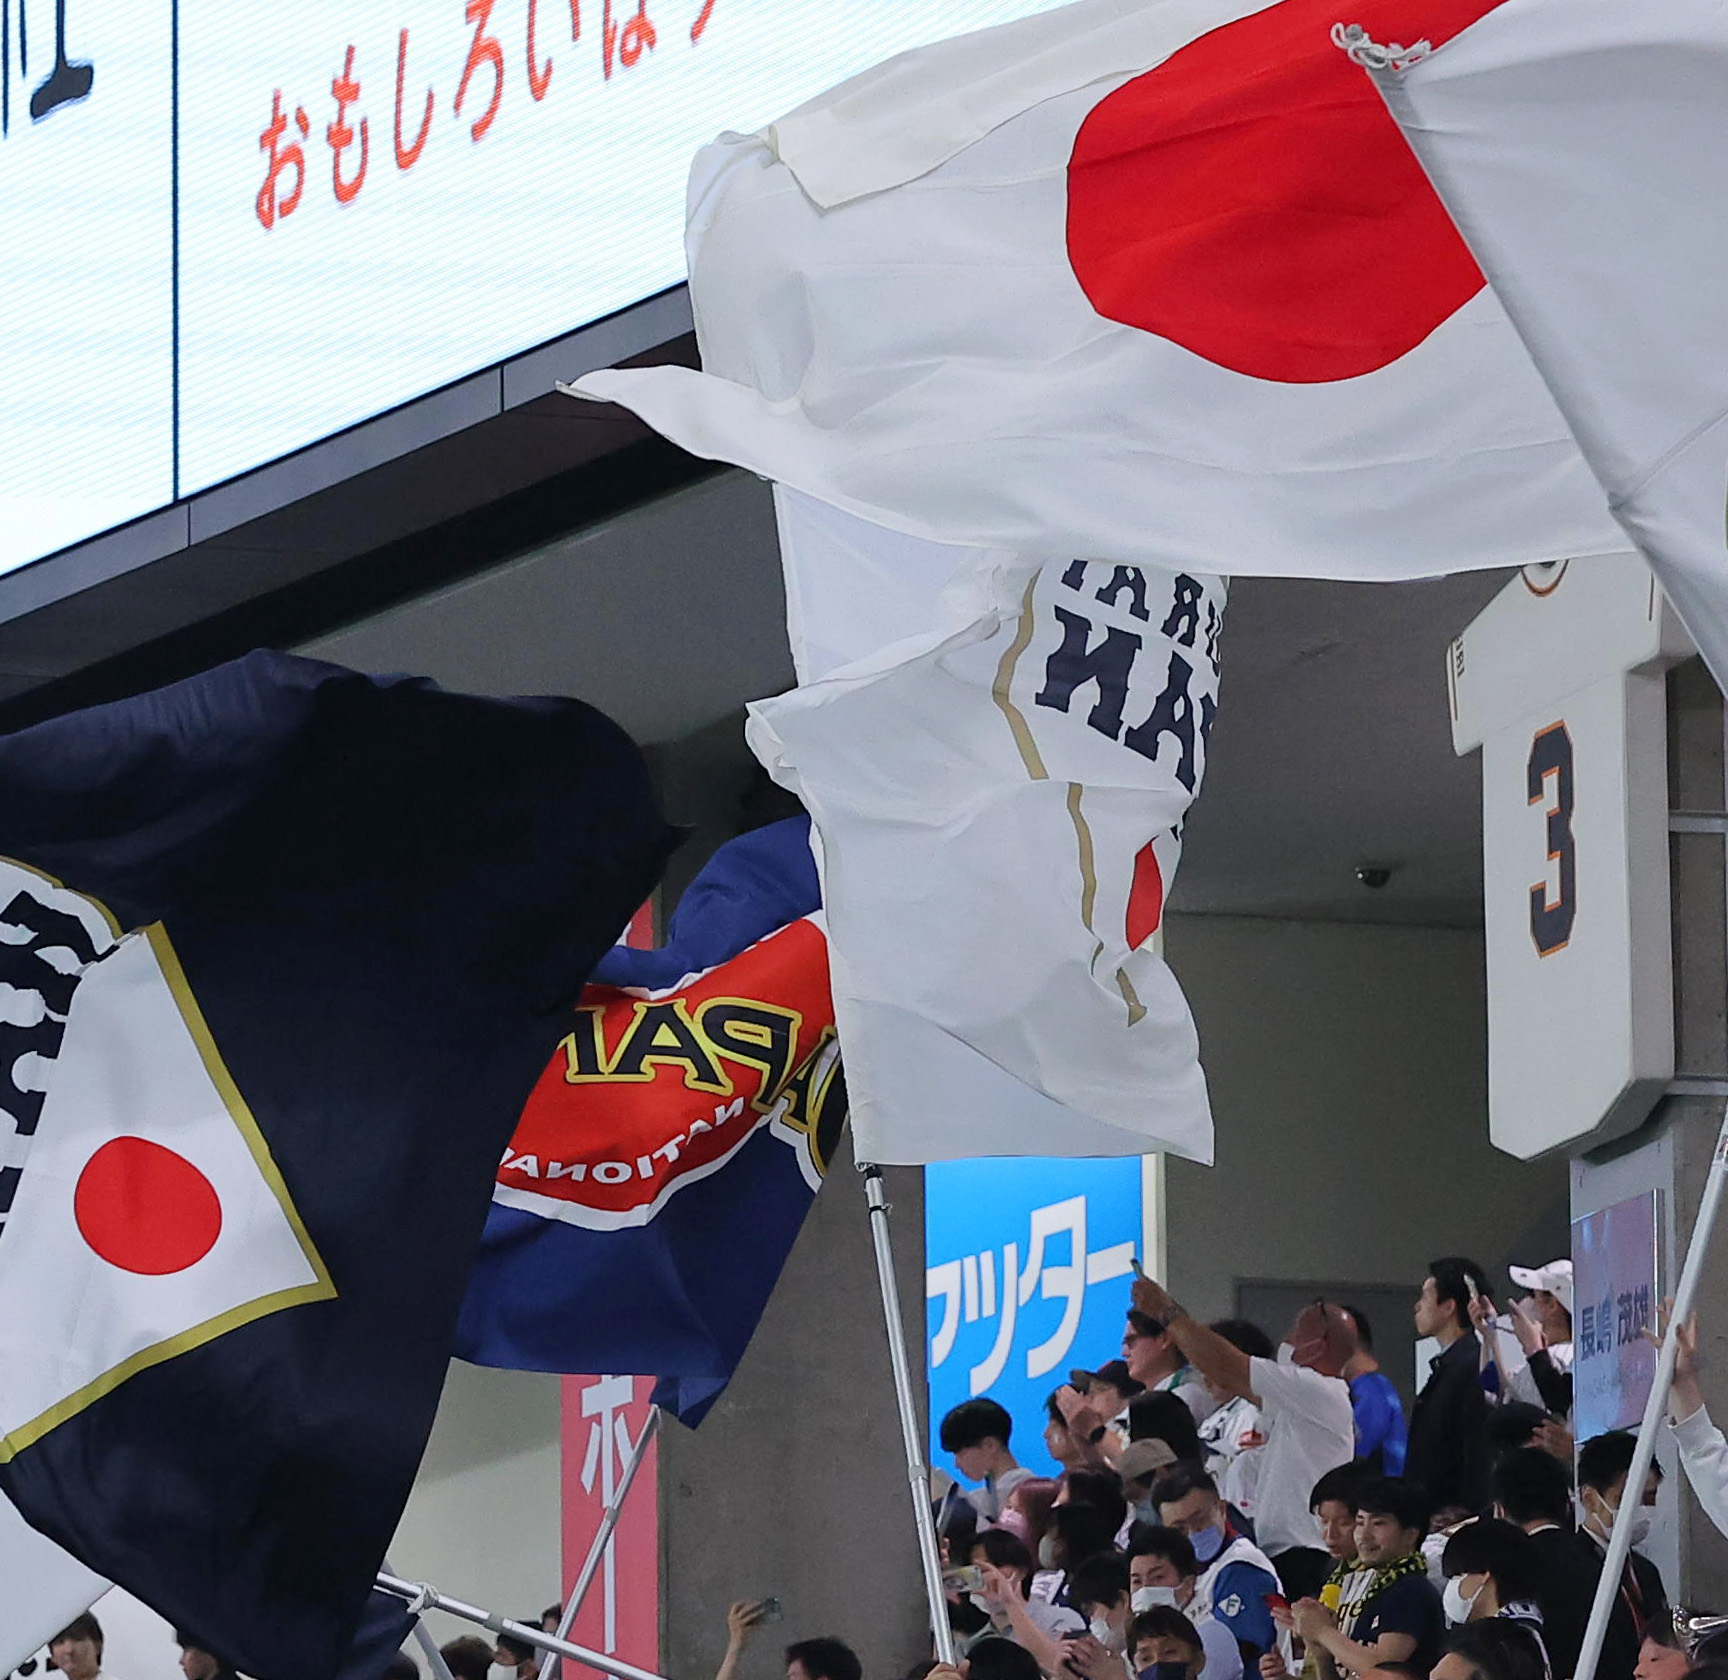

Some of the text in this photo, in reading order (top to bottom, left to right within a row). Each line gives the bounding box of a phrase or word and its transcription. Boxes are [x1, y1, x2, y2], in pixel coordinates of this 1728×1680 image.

[254, 0, 715, 229] おもしろい
[1528, 719, 1575, 957] 3
